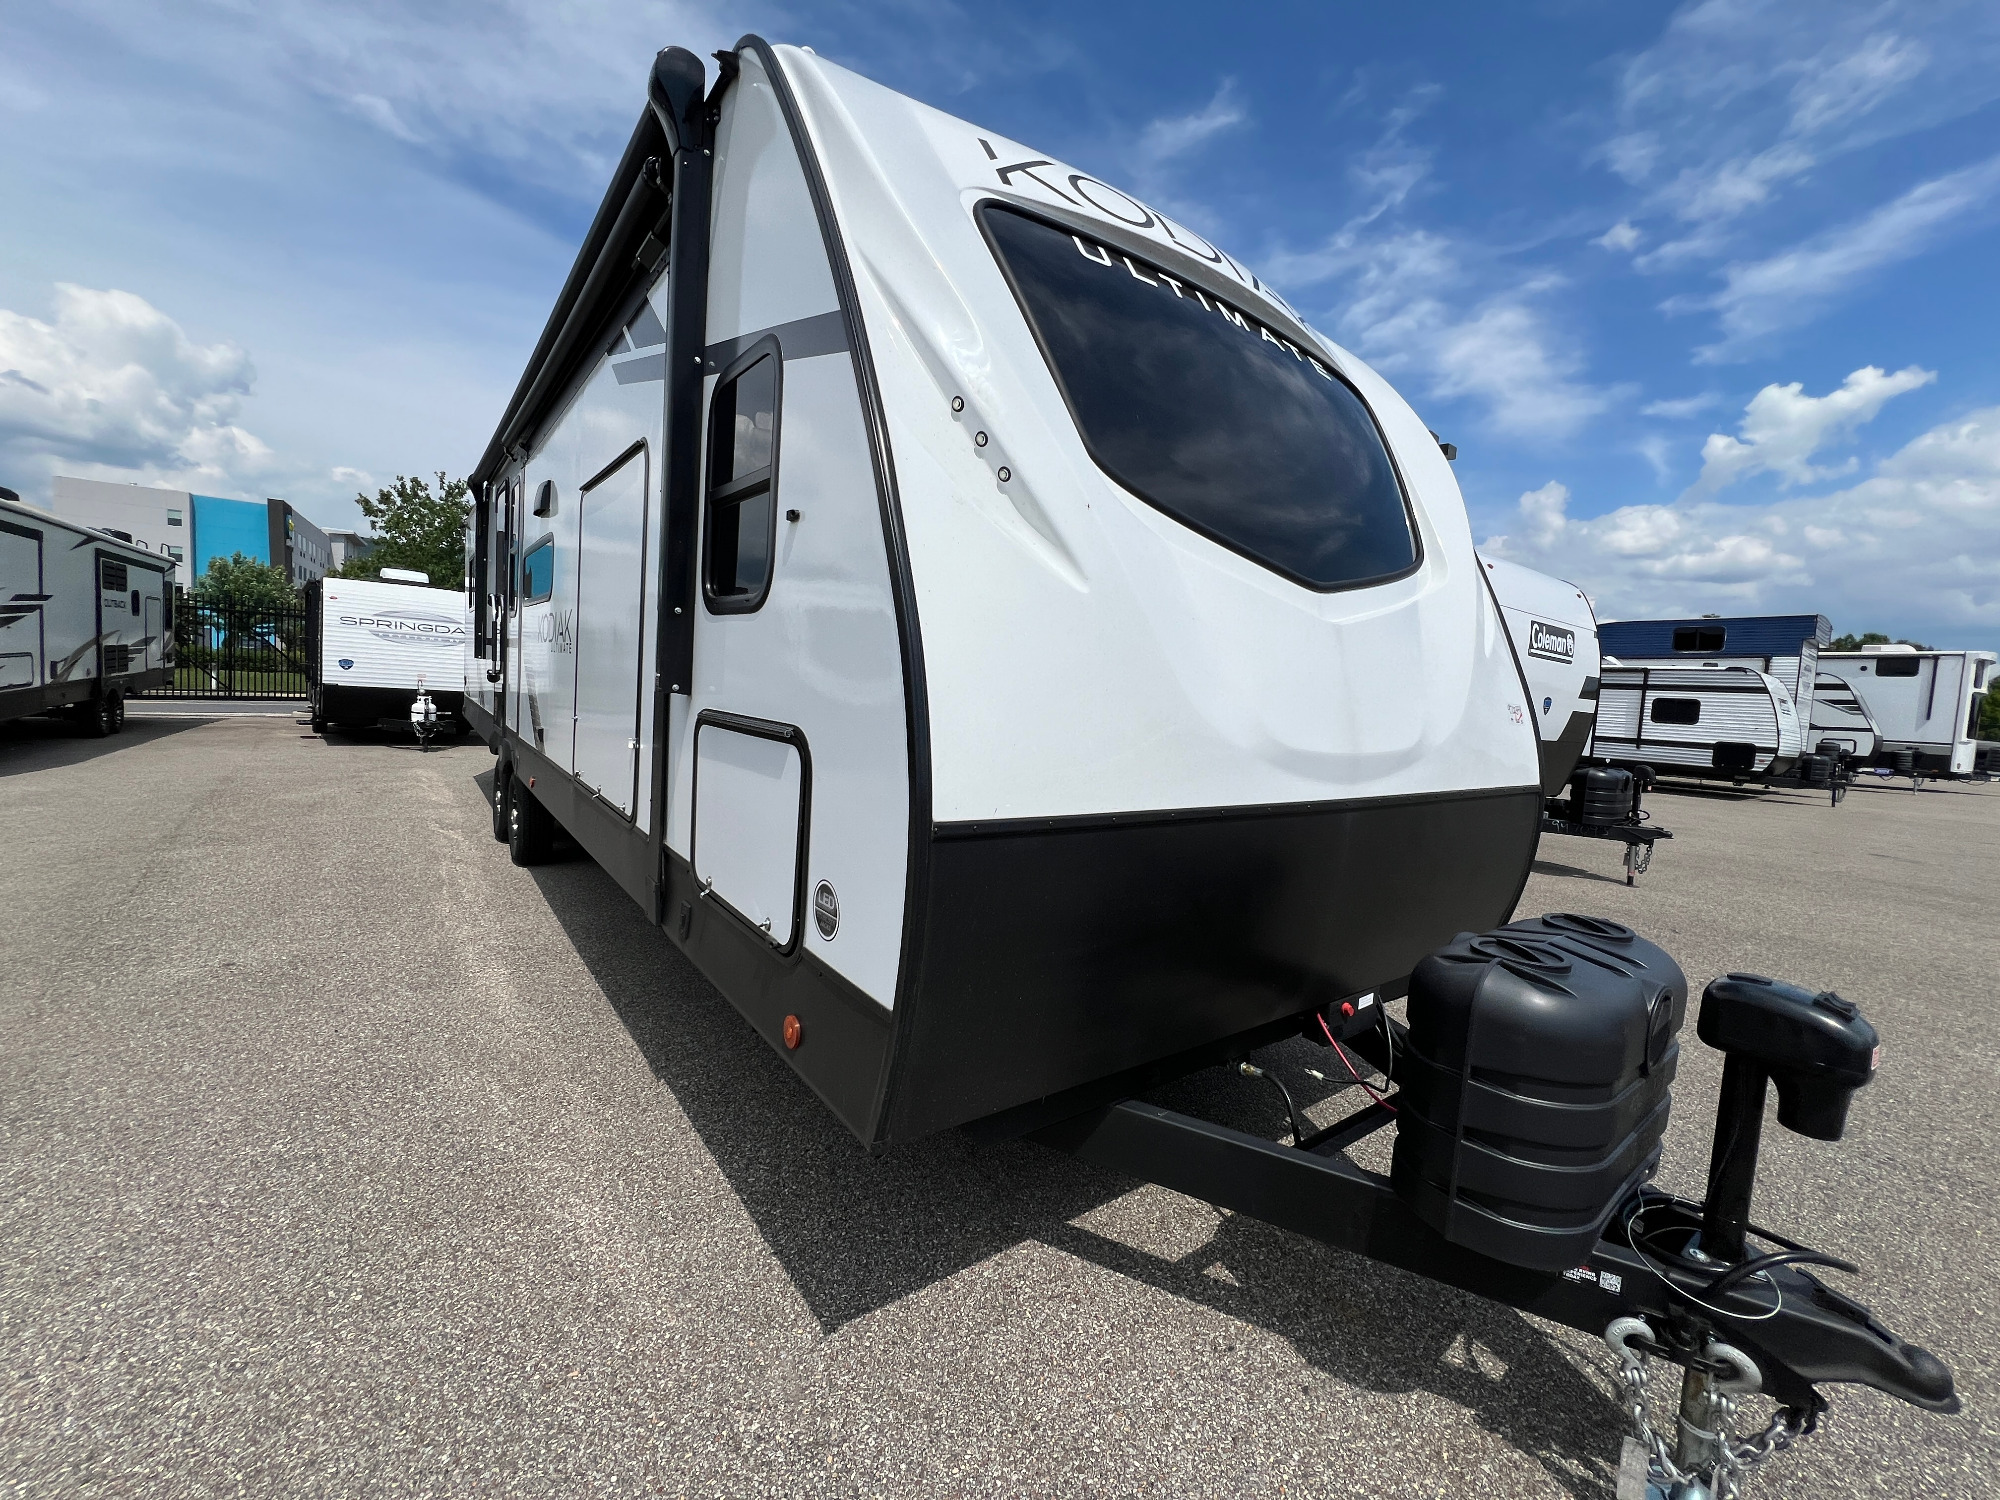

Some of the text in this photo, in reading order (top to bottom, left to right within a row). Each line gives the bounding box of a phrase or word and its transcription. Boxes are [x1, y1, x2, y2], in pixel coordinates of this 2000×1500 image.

[1072, 235, 1332, 381] ULTIMATE
[537, 609, 572, 643] KODIAK
[1531, 623, 1567, 654] Coleman
[818, 889, 835, 910] LED
